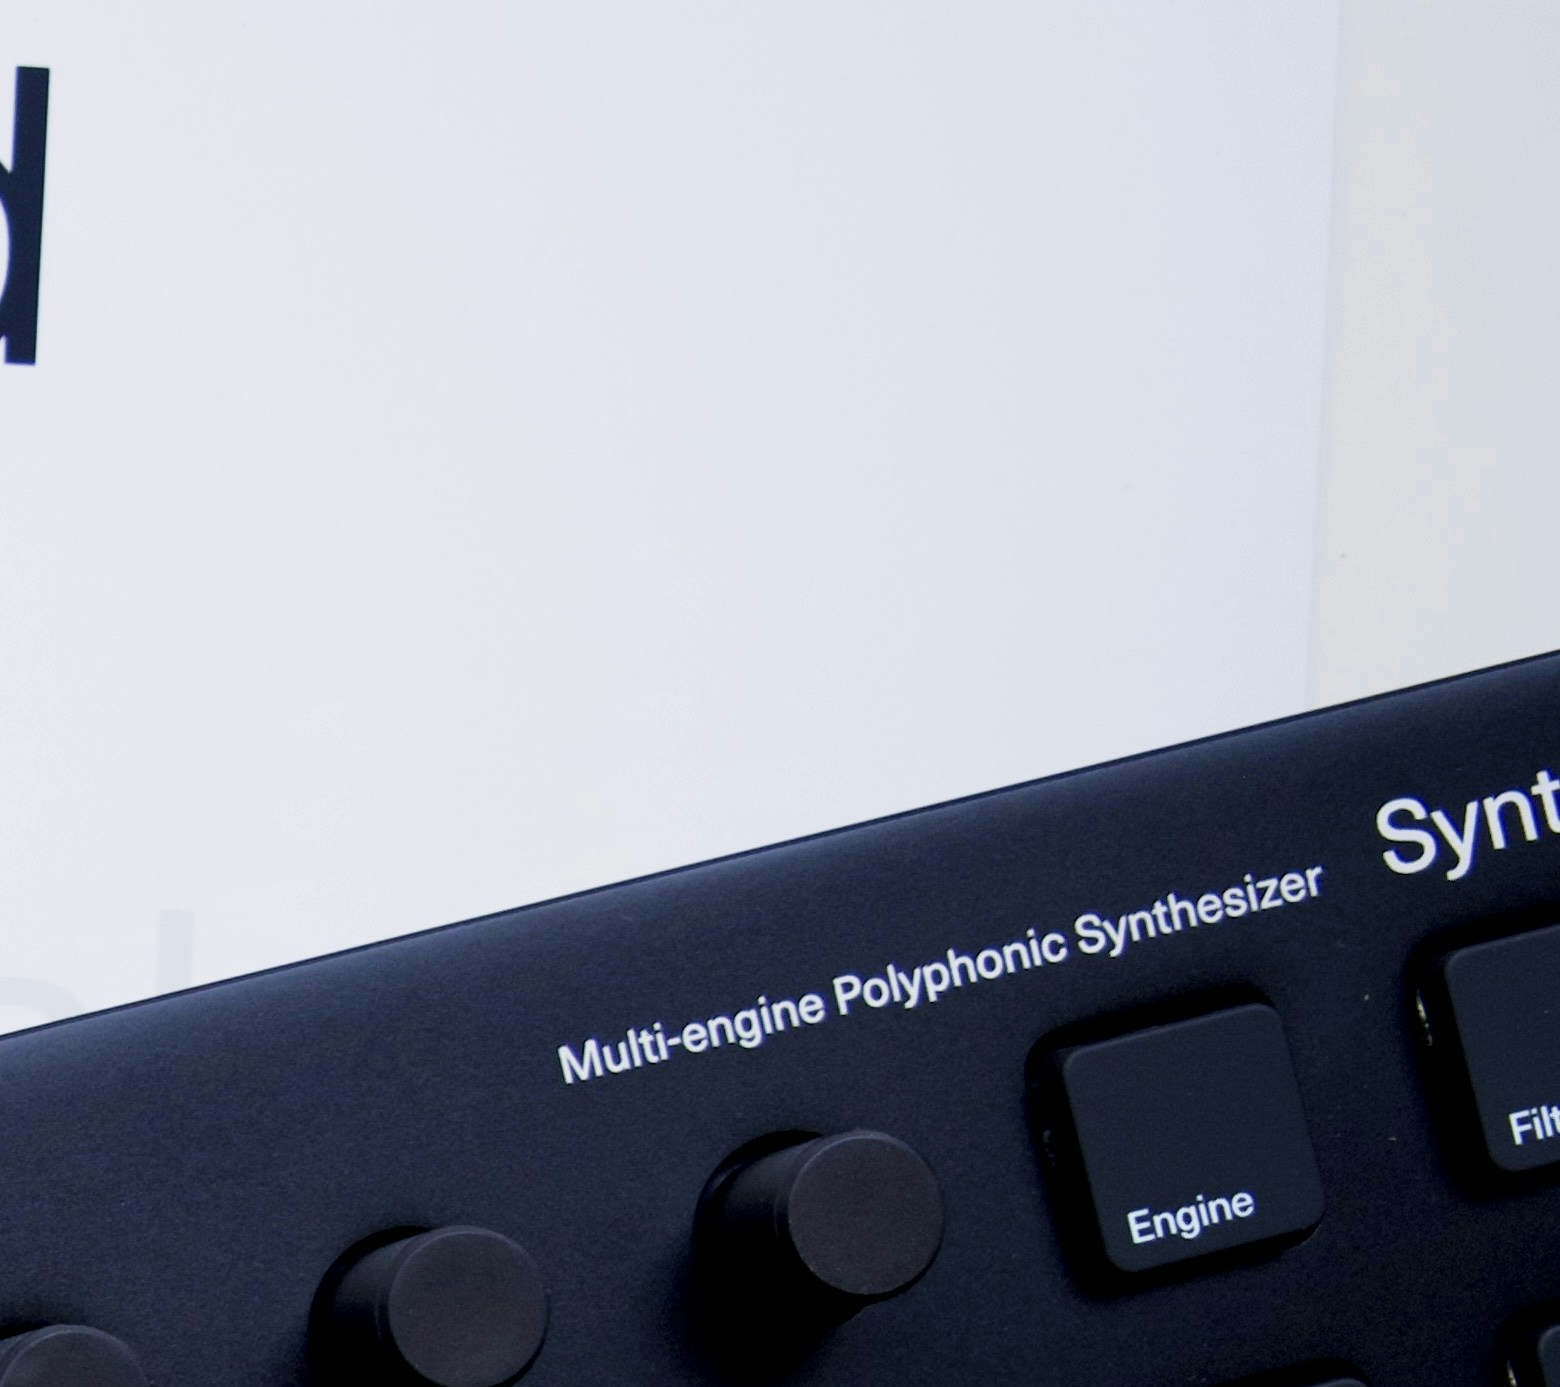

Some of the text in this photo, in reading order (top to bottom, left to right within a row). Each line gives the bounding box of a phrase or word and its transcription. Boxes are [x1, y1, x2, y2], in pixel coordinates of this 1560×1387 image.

[557, 865, 1323, 1084] Multi-engine Polyphonic Synthesizer
[1126, 1191, 1255, 1244] Engine
